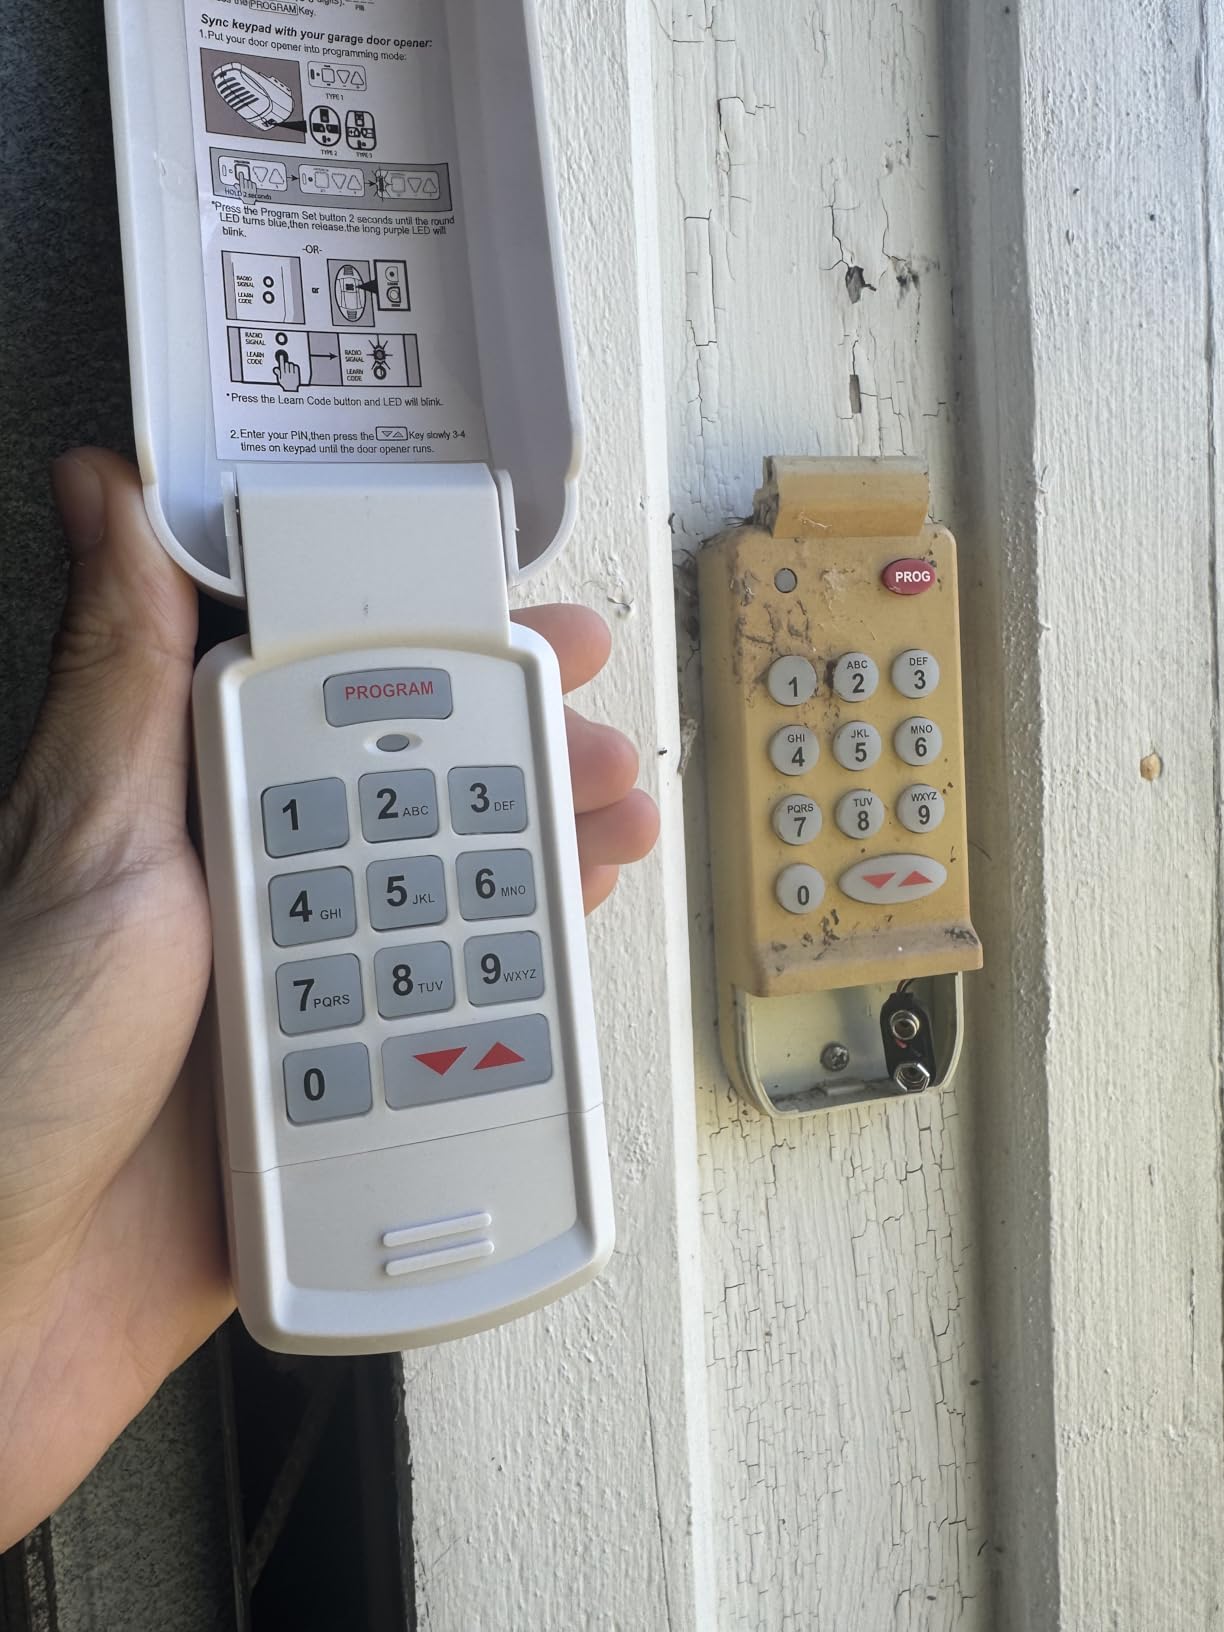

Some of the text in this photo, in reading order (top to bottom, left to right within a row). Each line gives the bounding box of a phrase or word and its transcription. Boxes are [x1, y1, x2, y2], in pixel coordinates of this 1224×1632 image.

[250, 0, 296, 14] PROGRAM
[201, 14, 432, 49] Sync keypad with your garage door opener:
[226, 34, 246, 44] your
[248, 37, 268, 46] door
[271, 42, 301, 52] opener
[304, 43, 320, 54] into
[323, 46, 378, 60] programming
[220, 212, 240, 222] LED
[242, 216, 265, 226] turns
[362, 224, 380, 236] long
[384, 226, 410, 236] purple
[412, 226, 430, 234] LED
[432, 226, 446, 235] will
[244, 206, 258, 216] the
[260, 208, 300, 220] Program
[320, 212, 346, 222] button
[349, 214, 354, 222] 2
[358, 216, 392, 224] seconds
[396, 216, 412, 225] until
[416, 217, 428, 226] the
[431, 216, 454, 225] round
[222, 226, 246, 238] blink.
[302, 244, 322, 254] -OR-
[260, 394, 276, 404] the
[306, 396, 332, 406] Code
[334, 396, 362, 406] button
[364, 397, 380, 406] and
[384, 397, 402, 406] LED
[404, 397, 418, 406] will
[268, 432, 288, 442] your
[333, 433, 358, 442] press
[360, 431, 374, 440] the
[409, 431, 424, 440] Key
[240, 442, 434, 455] times on keypad until the door opener runs.
[895, 570, 930, 582] PROG
[847, 660, 868, 669] ABC
[909, 656, 928, 666] DEF
[788, 676, 798, 698] 1
[852, 673, 864, 694] 2
[914, 670, 926, 690] 3
[344, 681, 434, 700] PROGRAM
[788, 734, 805, 742] GHI
[850, 728, 870, 738] JKL
[910, 724, 932, 734] MNO
[792, 746, 805, 767] 4
[855, 742, 867, 762] 5
[914, 737, 928, 756] 6
[376, 788, 429, 820] 2 ABC
[470, 782, 516, 812] 3 DEF
[854, 798, 873, 807] TUV
[912, 792, 937, 802] WXYZ
[282, 798, 300, 831] 1
[787, 803, 814, 814] PQRS
[918, 804, 930, 825] 9
[794, 816, 806, 838] 7
[858, 810, 870, 831] 8
[386, 875, 434, 906] 5 JKL
[475, 868, 526, 899] 6 MNO
[289, 890, 342, 922] 4 GHI
[797, 886, 809, 906] 0
[480, 953, 536, 984] 9 WXYZ
[392, 964, 444, 996] 8 TUV
[293, 978, 350, 1012] 7 PQRS
[303, 1068, 326, 1100] 0
